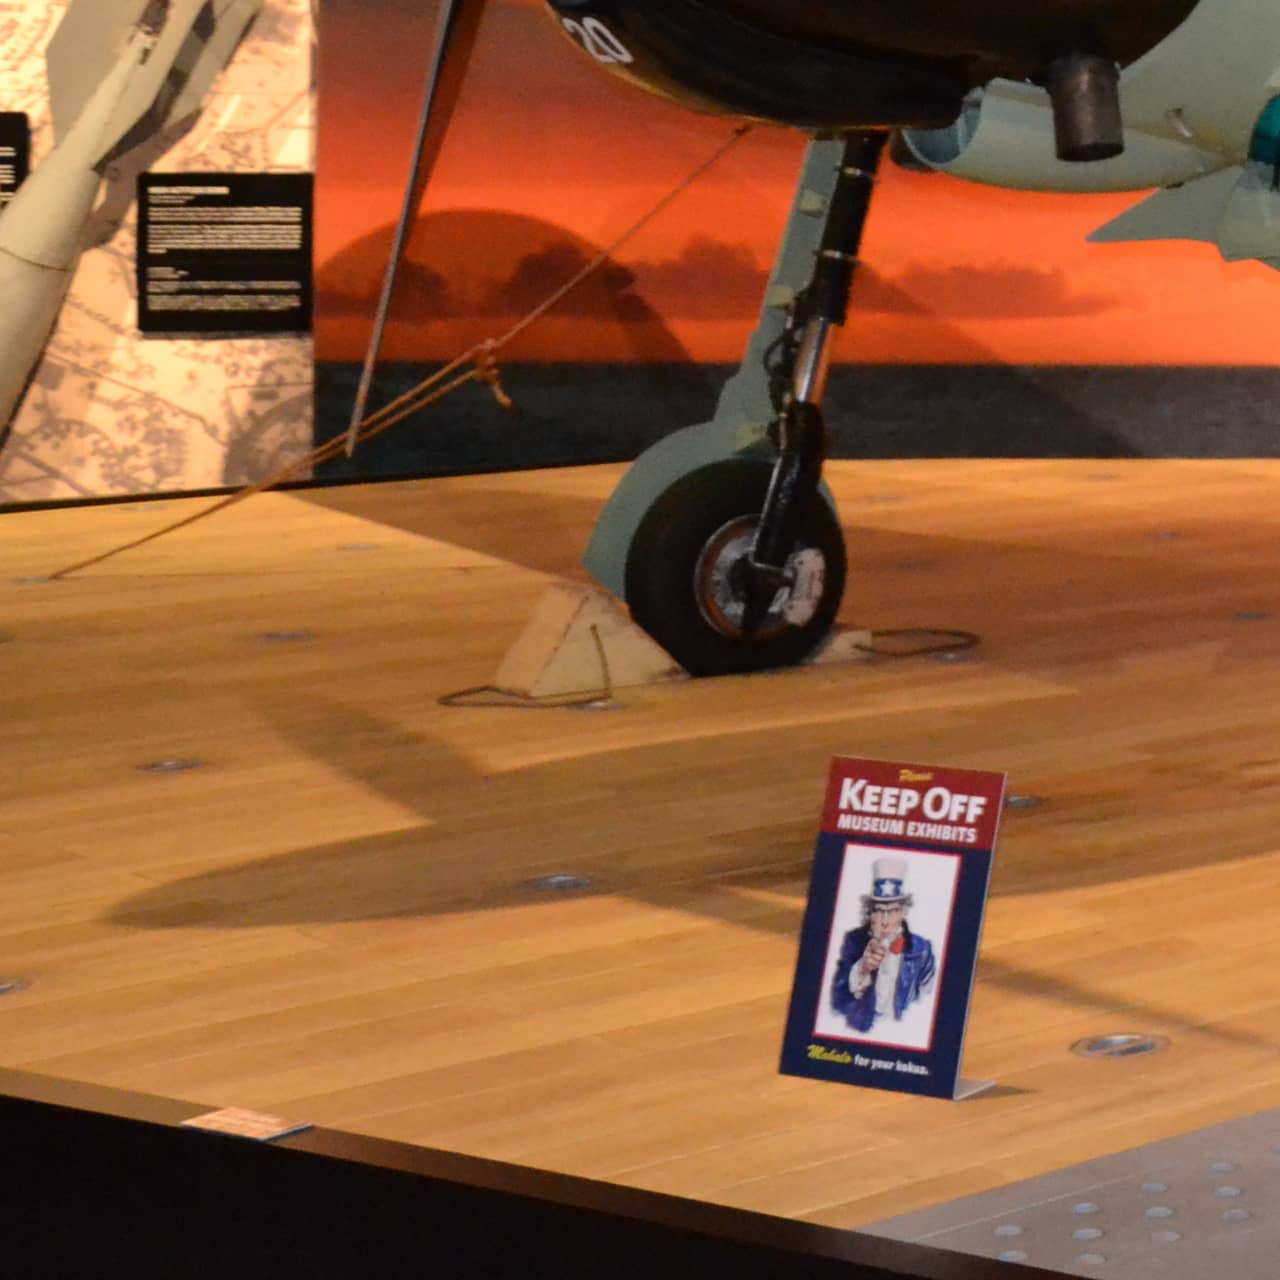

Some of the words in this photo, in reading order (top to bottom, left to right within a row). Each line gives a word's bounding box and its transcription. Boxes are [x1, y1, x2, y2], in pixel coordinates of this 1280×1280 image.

[561, 16, 634, 64] 20
[839, 778, 919, 816] KEEP
[922, 786, 987, 823] OFF
[837, 814, 904, 835] MUSEUM
[906, 821, 977, 843] EXHIBITS
[854, 1054, 869, 1066] for
[870, 1059, 895, 1070] your
